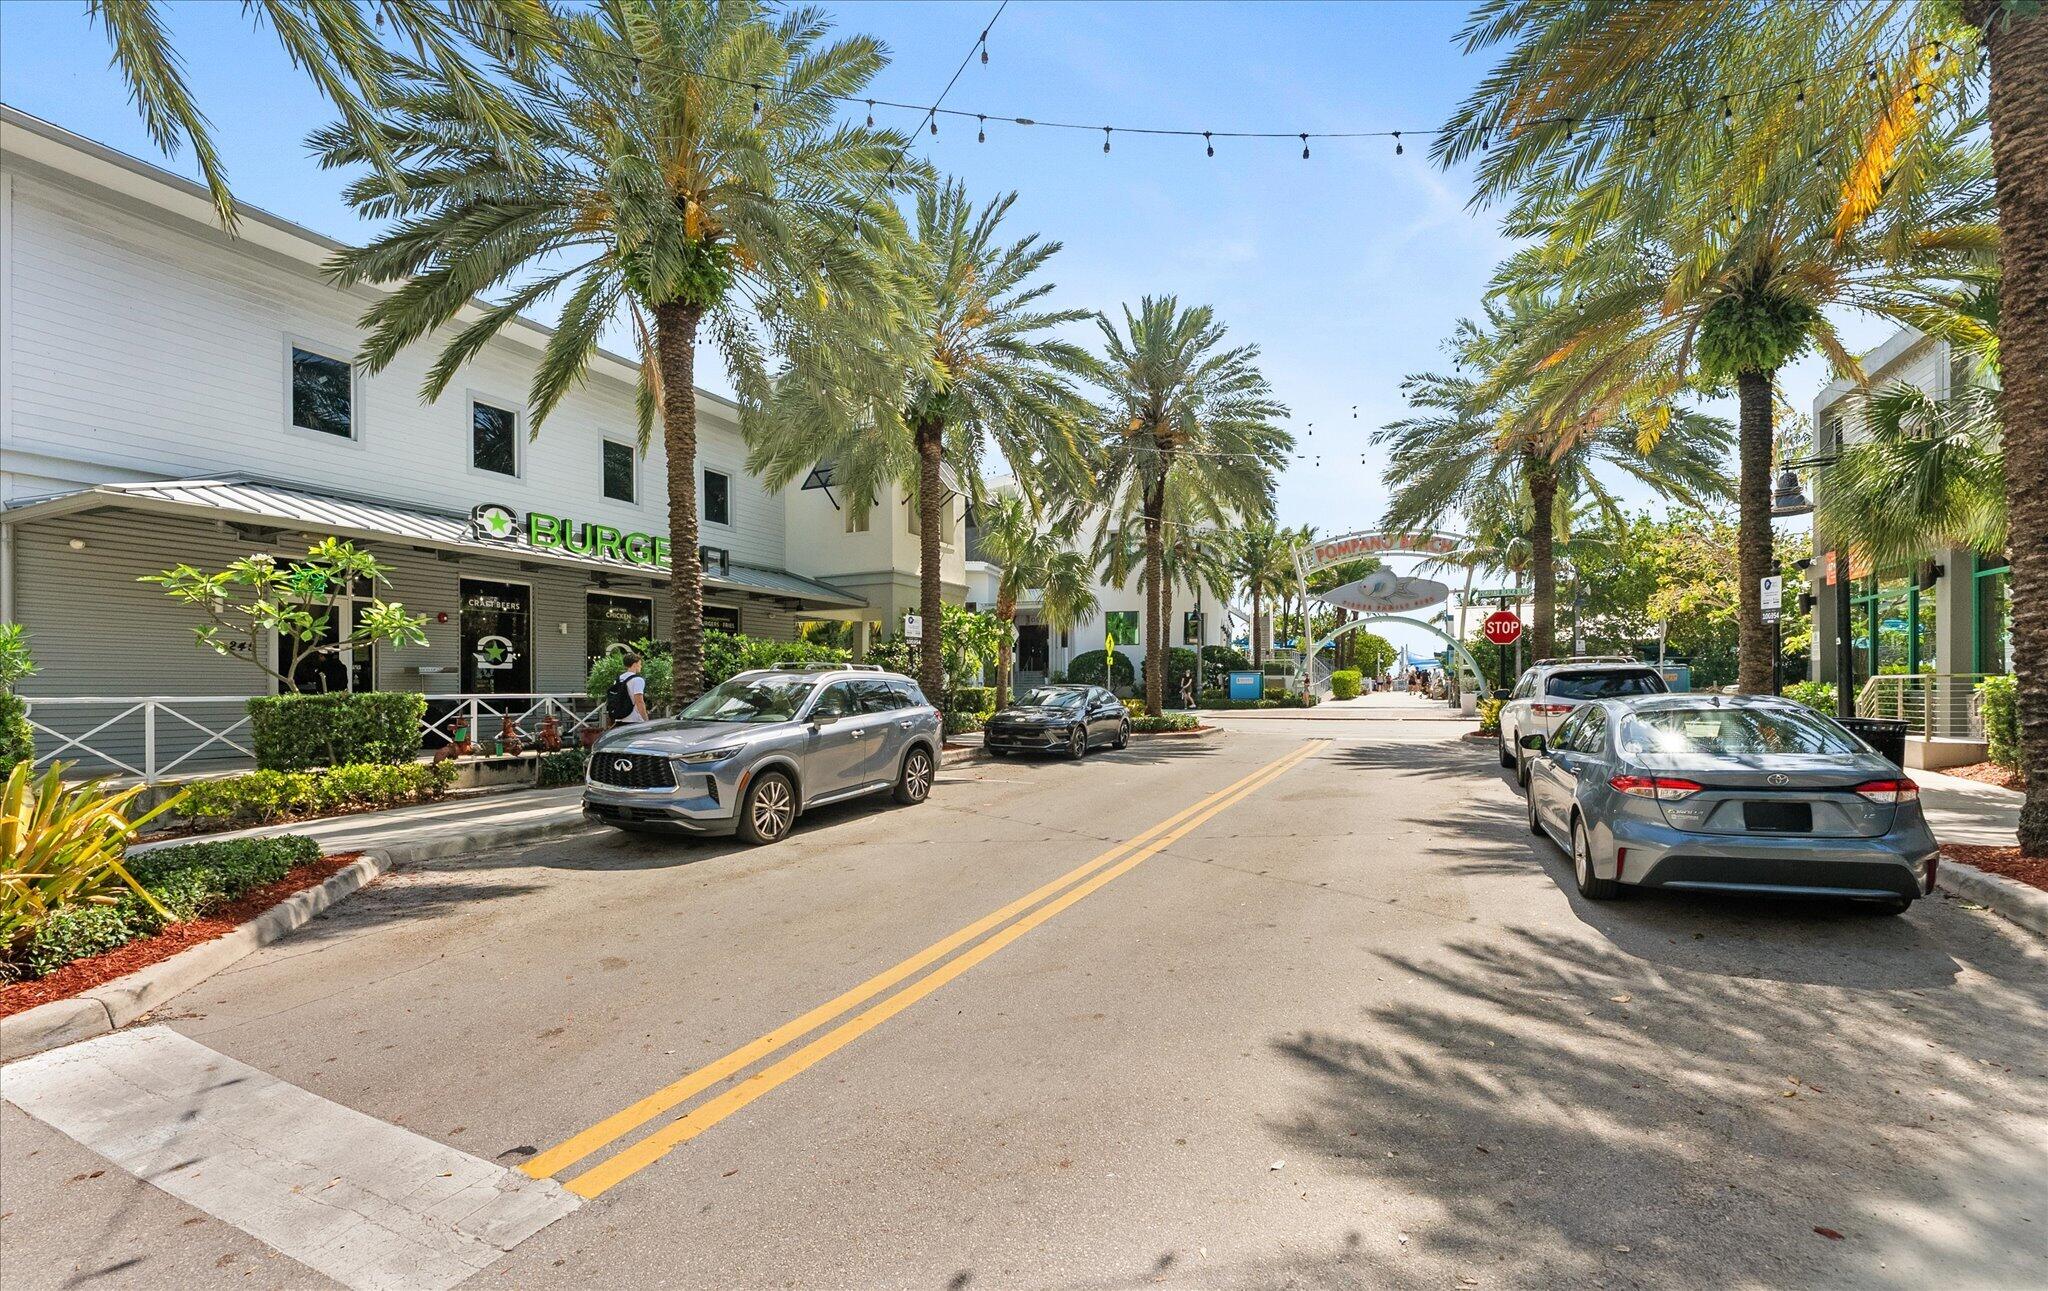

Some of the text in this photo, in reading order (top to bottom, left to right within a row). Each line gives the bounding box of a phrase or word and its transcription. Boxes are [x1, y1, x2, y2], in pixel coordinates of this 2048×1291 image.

[526, 512, 729, 576] BURGEFI
[1315, 533, 1454, 562] POMPANO BECH
[496, 601, 520, 610] BEERS
[605, 611, 632, 620] CHICKEN
[1486, 621, 1519, 634] STOP
